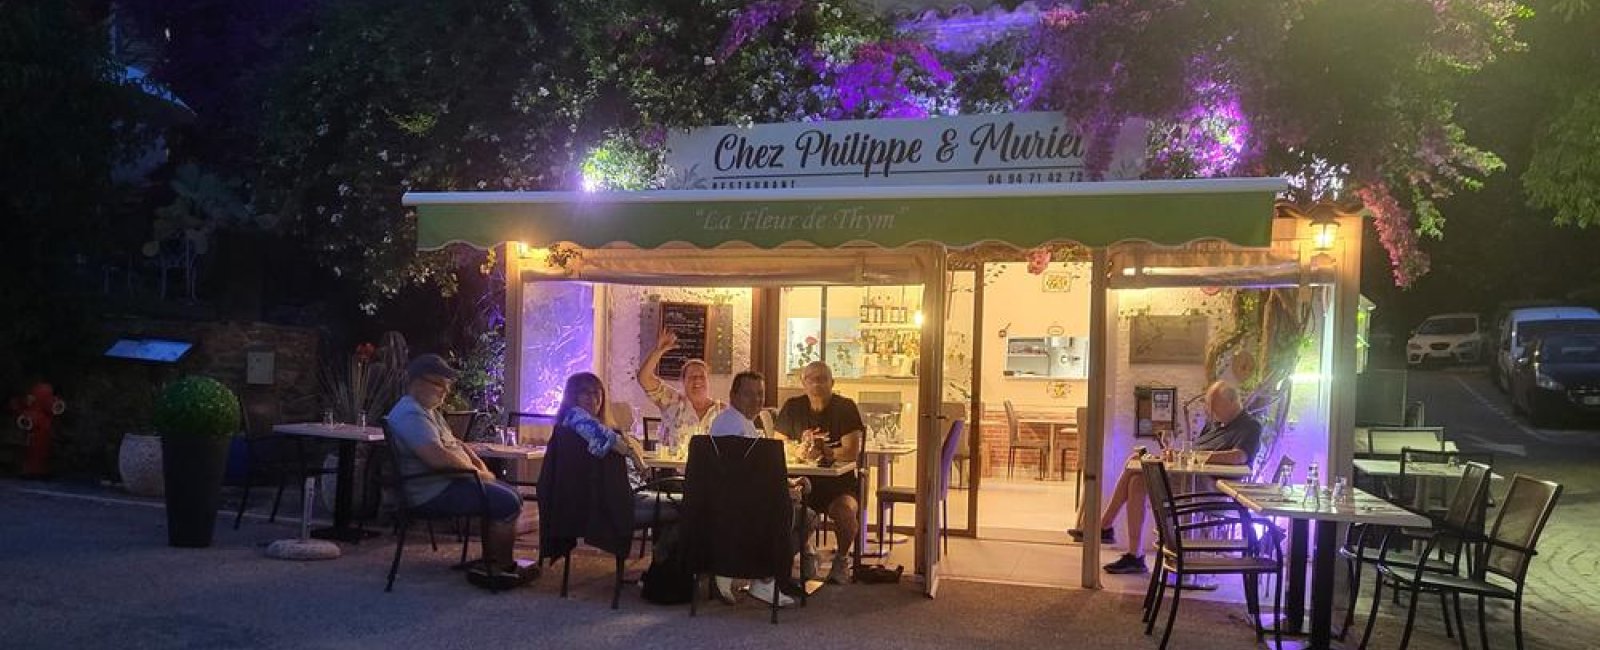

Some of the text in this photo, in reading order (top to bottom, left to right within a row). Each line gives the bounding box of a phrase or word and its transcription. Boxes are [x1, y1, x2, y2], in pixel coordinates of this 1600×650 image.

[714, 133, 785, 171] Chez
[796, 128, 922, 176] Philippe
[935, 128, 959, 163] &
[738, 206, 798, 231] Fleur
[802, 205, 828, 230] de
